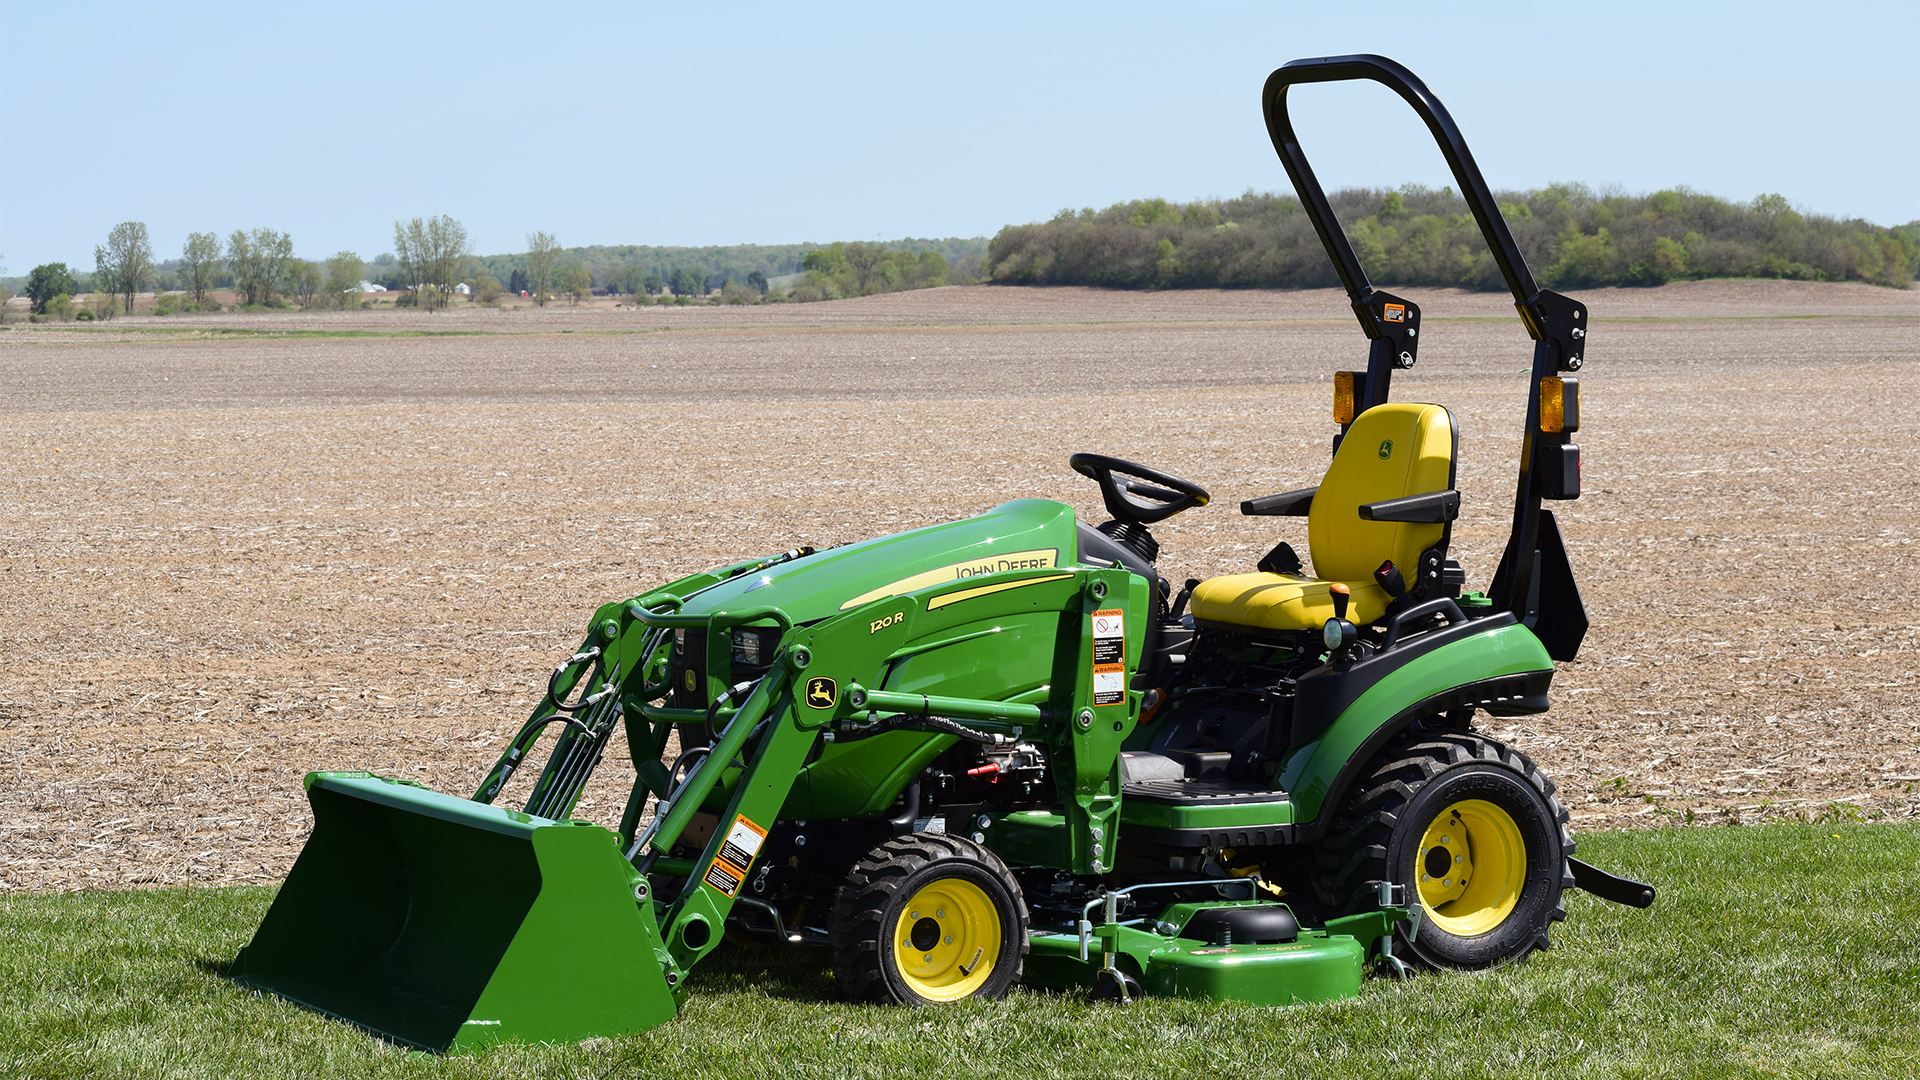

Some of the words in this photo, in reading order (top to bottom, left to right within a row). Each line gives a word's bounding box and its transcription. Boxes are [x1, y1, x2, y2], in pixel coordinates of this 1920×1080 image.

[956, 564, 994, 579] JOHN
[998, 558, 1048, 572] DEERE
[870, 616, 893, 634] 120
[894, 611, 904, 624] R
[1444, 775, 1536, 812] CARLISLE
[745, 820, 764, 835] WARNING
[722, 865, 741, 879] WARNING
